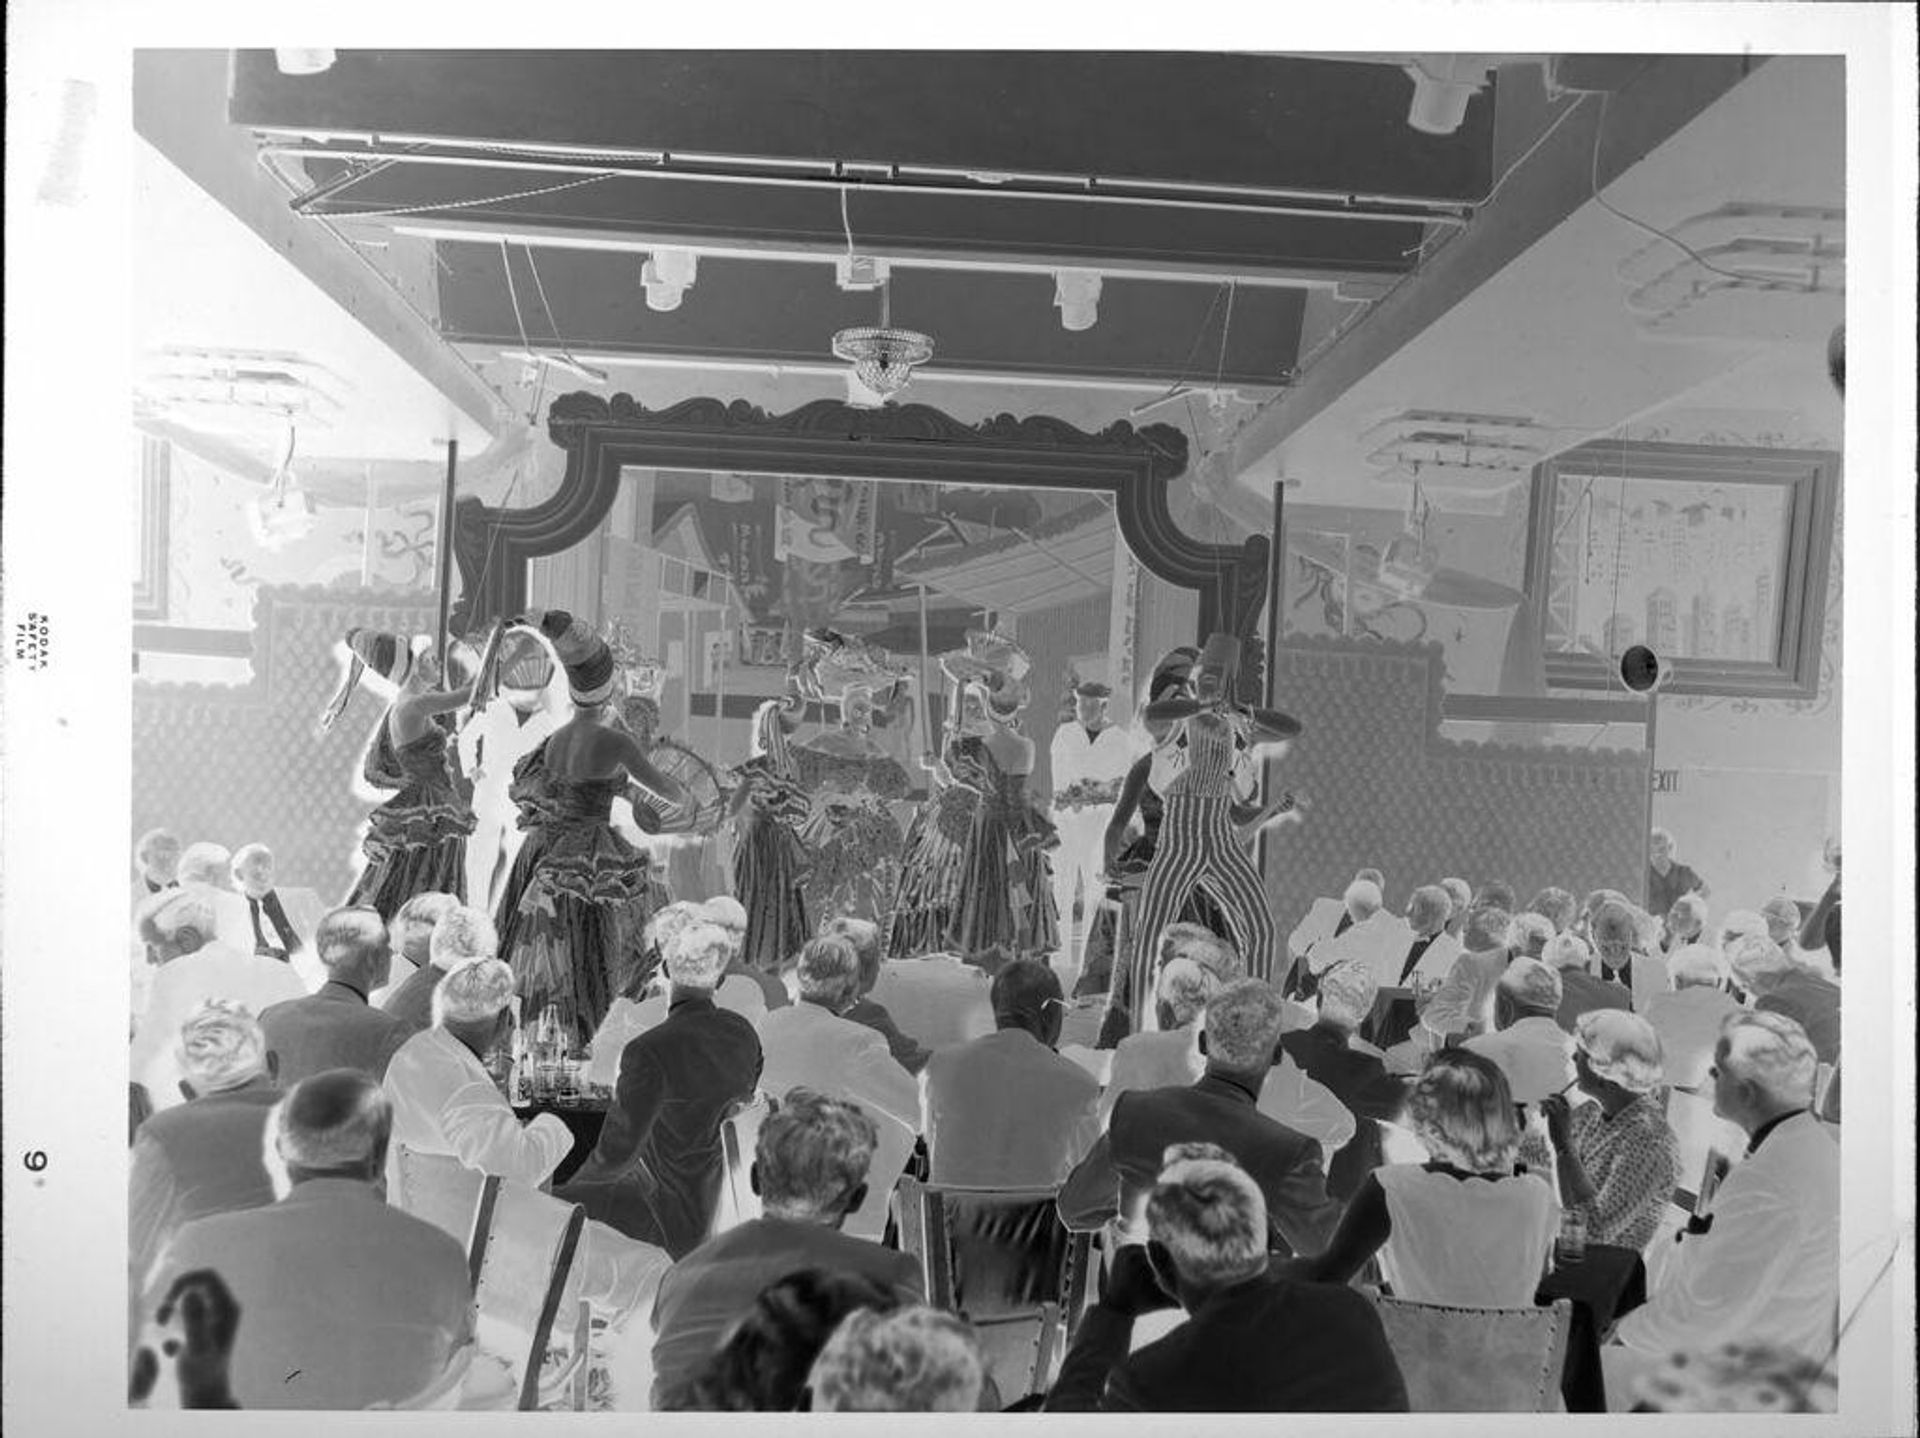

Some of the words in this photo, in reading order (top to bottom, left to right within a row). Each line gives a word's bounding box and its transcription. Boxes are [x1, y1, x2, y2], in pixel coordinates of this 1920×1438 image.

[15, 623, 26, 660] FILM
[28, 612, 39, 672] SAFETY
[39, 614, 50, 669] KODAK
[1652, 769, 1679, 792] EXIT
